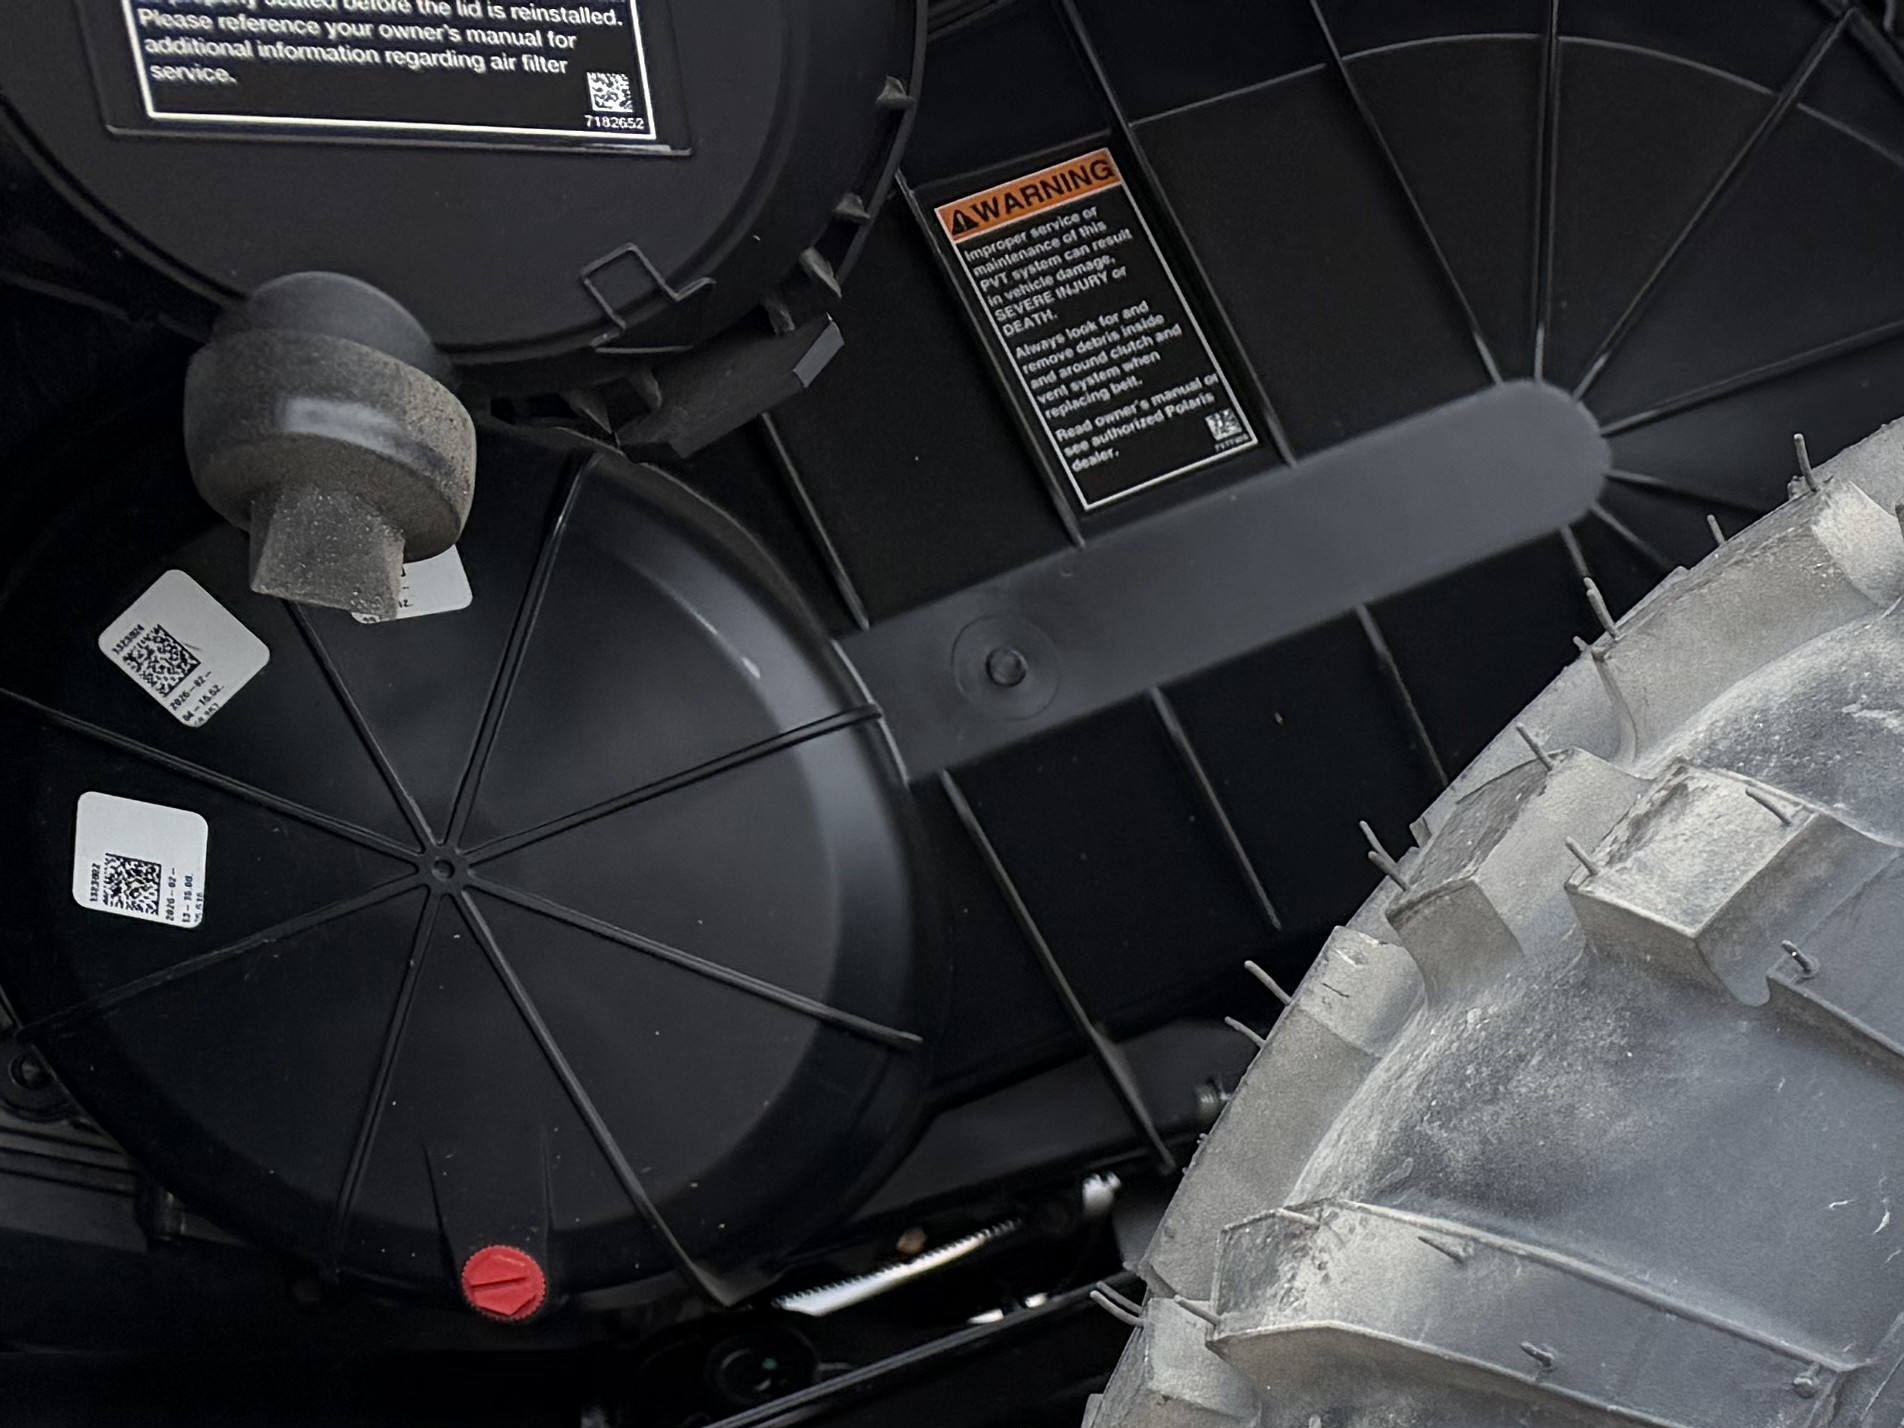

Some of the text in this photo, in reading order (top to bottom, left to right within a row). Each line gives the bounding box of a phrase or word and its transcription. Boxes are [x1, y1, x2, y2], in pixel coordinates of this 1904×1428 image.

[137, 7, 578, 49] Please reference your owner's manual for
[416, 0, 452, 17] the
[456, 0, 482, 18] lid
[486, 0, 506, 20] is
[510, 2, 623, 26] reinstalled.
[143, 36, 569, 74] additional information regarding air filter
[149, 62, 238, 84] service.
[584, 114, 645, 131] 7182652
[970, 159, 1115, 223] WARNING
[964, 206, 1098, 262] Improper service or
[972, 220, 1108, 277] maintenance of this
[980, 227, 1134, 293] PVT system can result
[986, 293, 1003, 308] in
[1003, 275, 1055, 301] vehicle
[994, 265, 1128, 322] SEVERE INJURY or
[1001, 308, 1059, 338] DEATH.
[1015, 300, 1150, 360] Always look for and
[1022, 312, 1166, 375] remove debris inside
[1029, 323, 1183, 391] and around clutch and
[1036, 349, 1162, 405] vent system when
[1044, 374, 1144, 420] replacing belt.
[1054, 372, 1220, 442] Read owner's manual or
[1062, 391, 1216, 458] see authorized Polaris
[1070, 447, 1120, 473] dealer.
